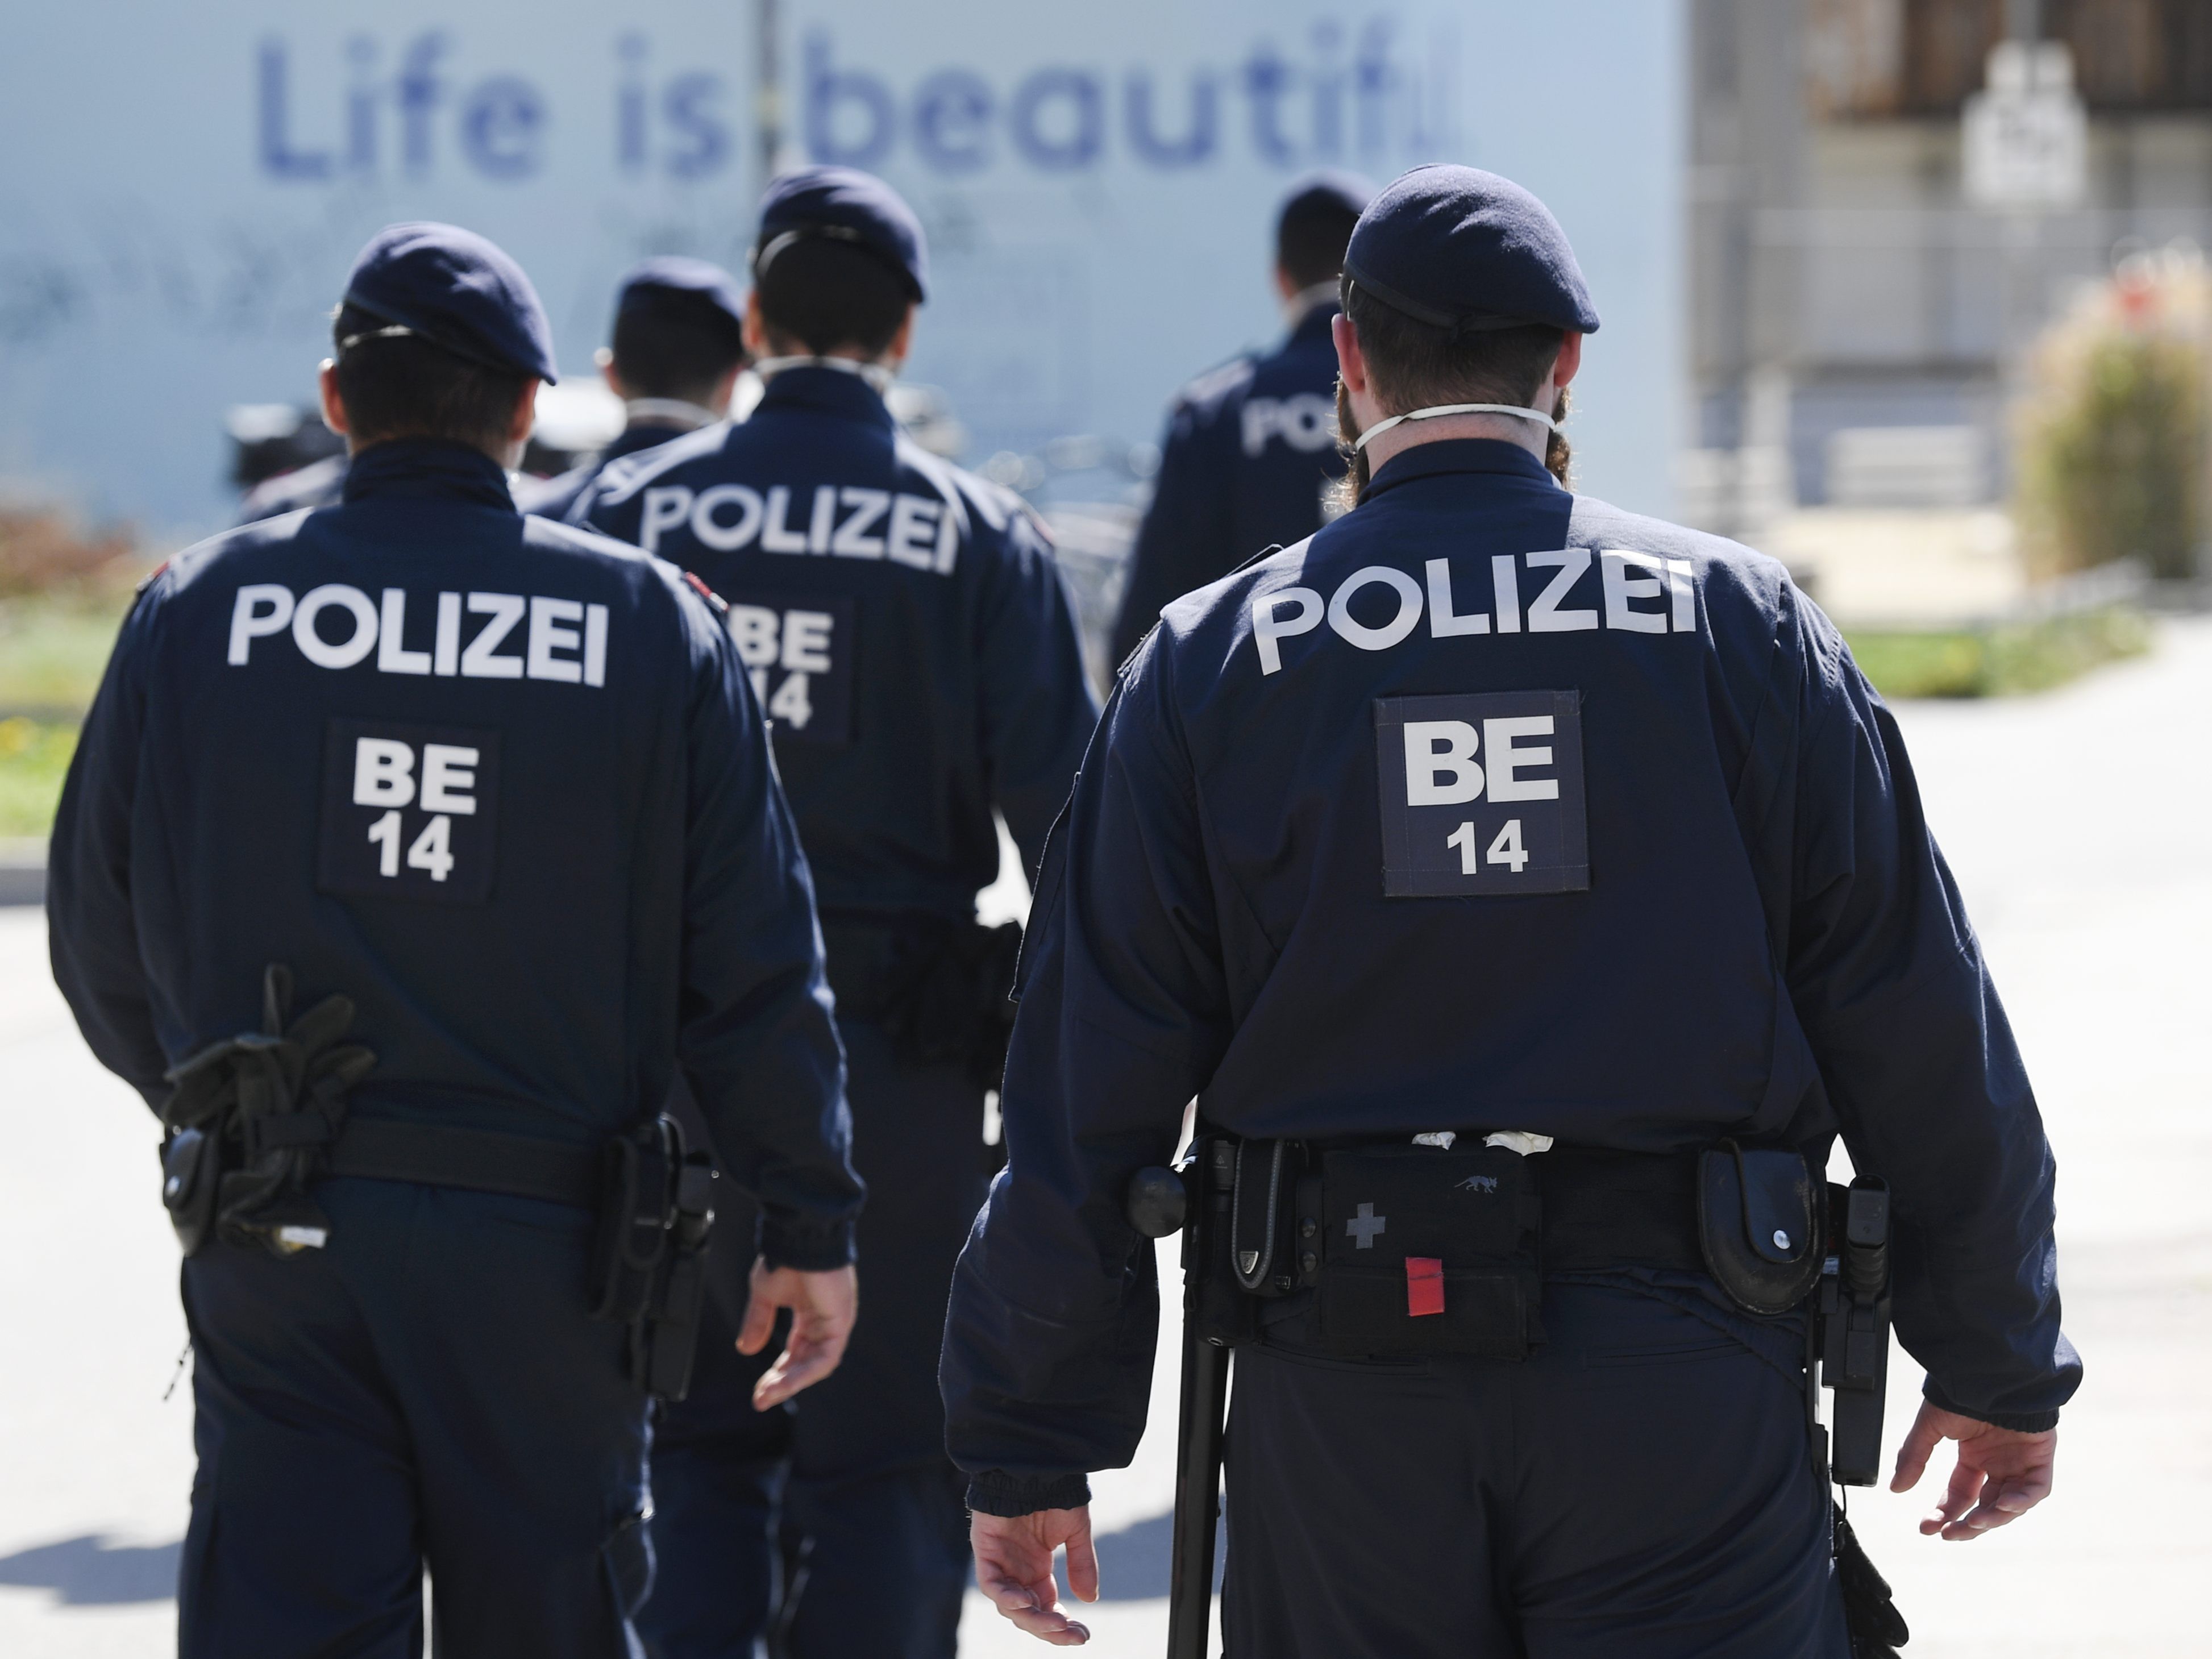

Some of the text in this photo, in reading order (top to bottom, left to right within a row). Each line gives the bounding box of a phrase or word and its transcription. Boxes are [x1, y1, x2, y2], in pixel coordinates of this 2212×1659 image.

[256, 27, 549, 183] Life
[614, 30, 733, 181] is
[640, 483, 959, 575] POLIZEI
[227, 583, 609, 688] POLIZEI
[726, 604, 834, 673] BE
[1251, 548, 1697, 676] POLIZEI
[352, 737, 480, 816] BE
[1403, 714, 1560, 807] BE
[367, 809, 455, 882] 14
[1446, 818, 1529, 875] 14
